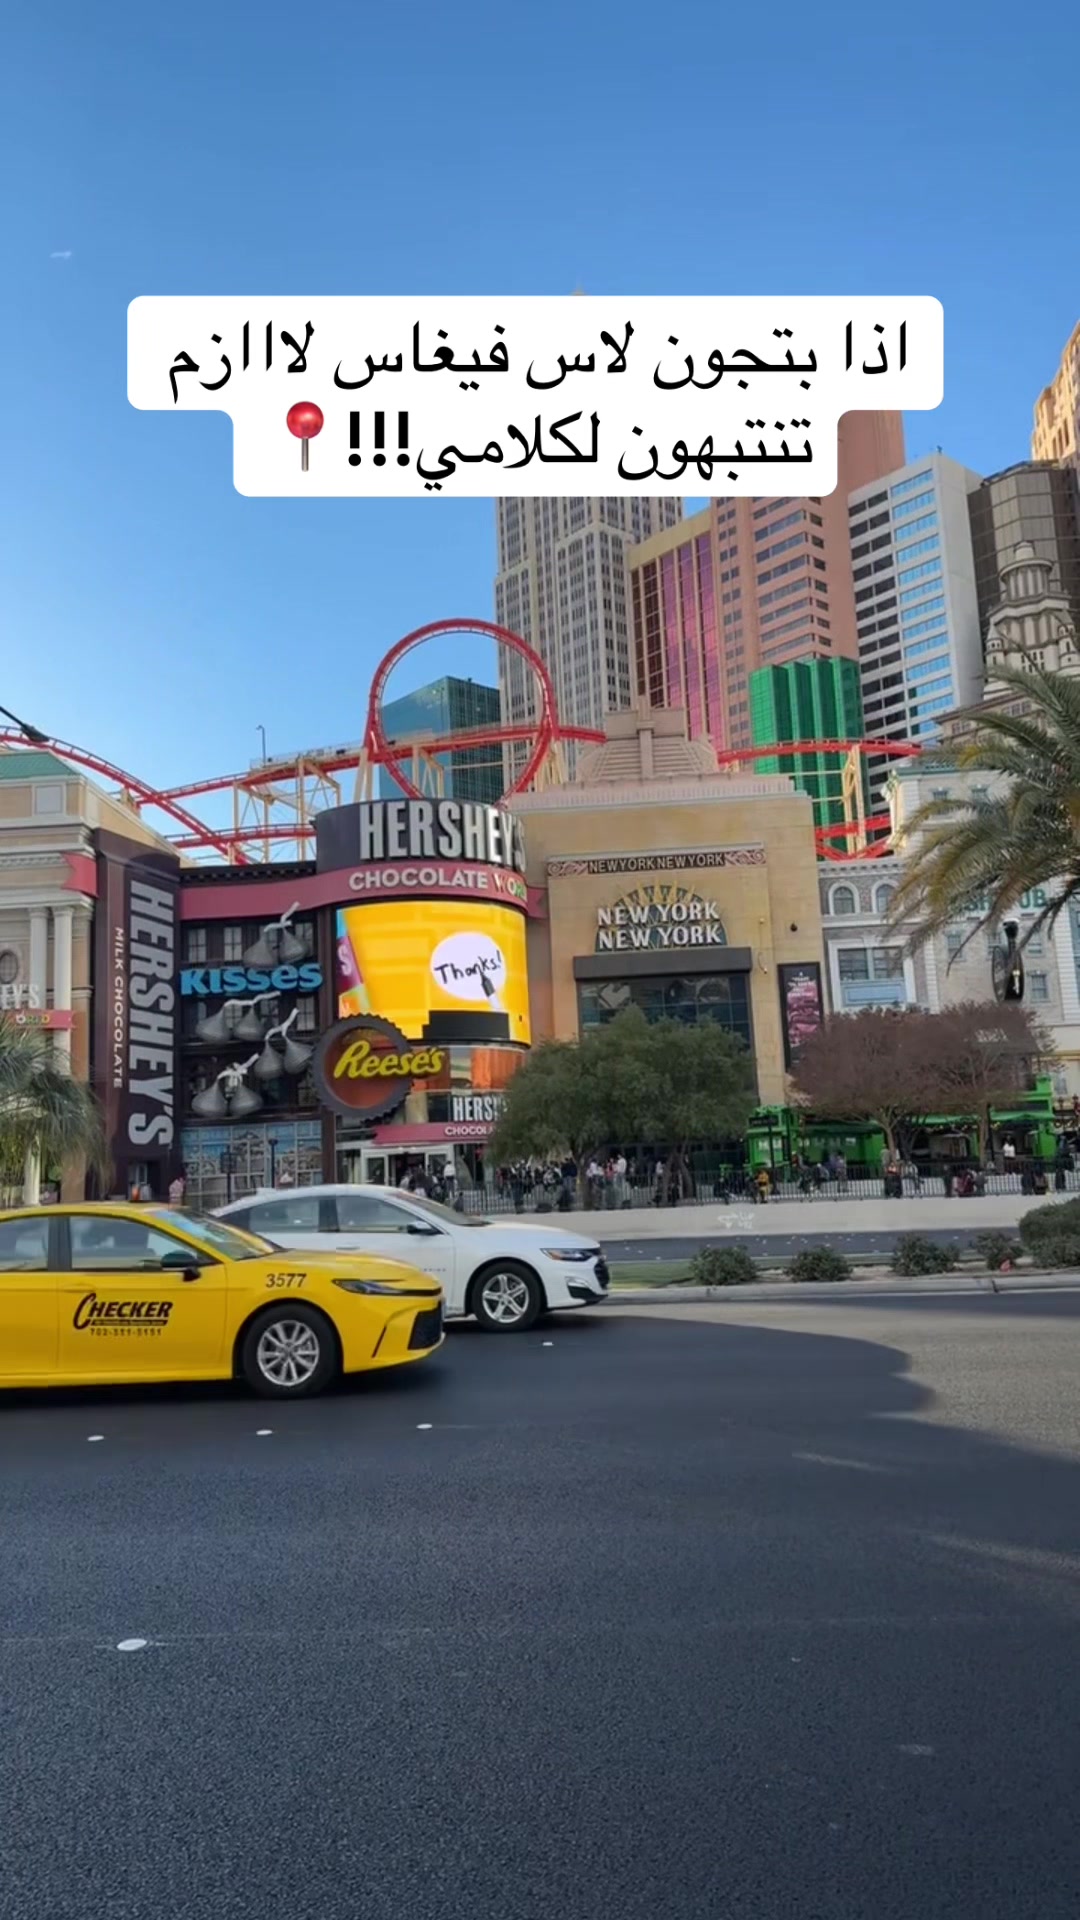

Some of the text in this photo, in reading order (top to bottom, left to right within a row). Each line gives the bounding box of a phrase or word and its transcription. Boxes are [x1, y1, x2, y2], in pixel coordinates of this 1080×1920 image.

[359, 799, 528, 873] HERSHEY'S
[349, 867, 489, 891] CHOCOLATE
[597, 901, 720, 926] NEW YORK
[599, 924, 722, 949] NEW YORK
[433, 950, 503, 984] Thanks!
[111, 926, 125, 1089] MILK CHOCOLATE
[127, 878, 175, 1146] HERSHEY'S
[333, 1040, 446, 1079] Reese's
[265, 1272, 307, 1289] 3577
